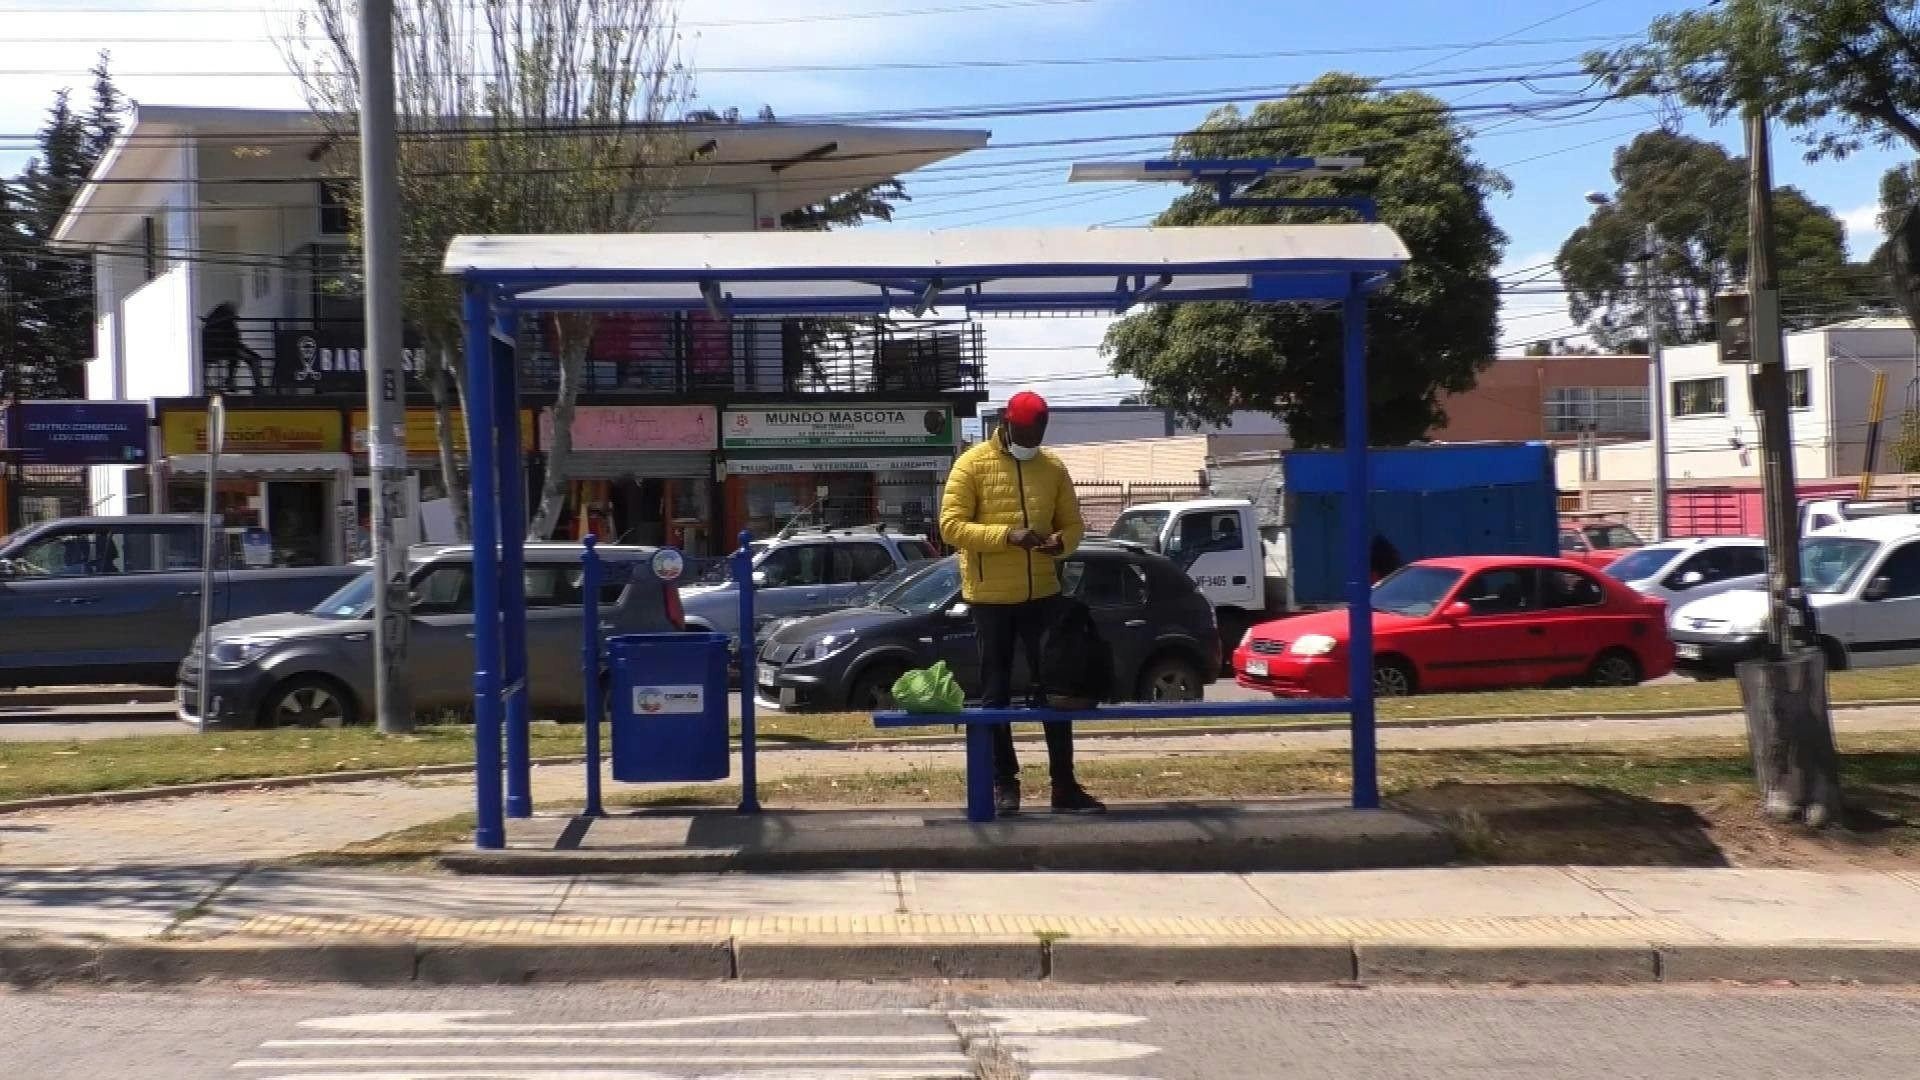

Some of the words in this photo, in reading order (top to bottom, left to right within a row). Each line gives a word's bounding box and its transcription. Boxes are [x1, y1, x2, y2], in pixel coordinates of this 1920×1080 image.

[766, 411, 824, 424] MUNDO
[829, 410, 905, 424] MASCOTA
[740, 463, 794, 472] PELUQUERIA
[812, 462, 869, 470] VETERINARIA
